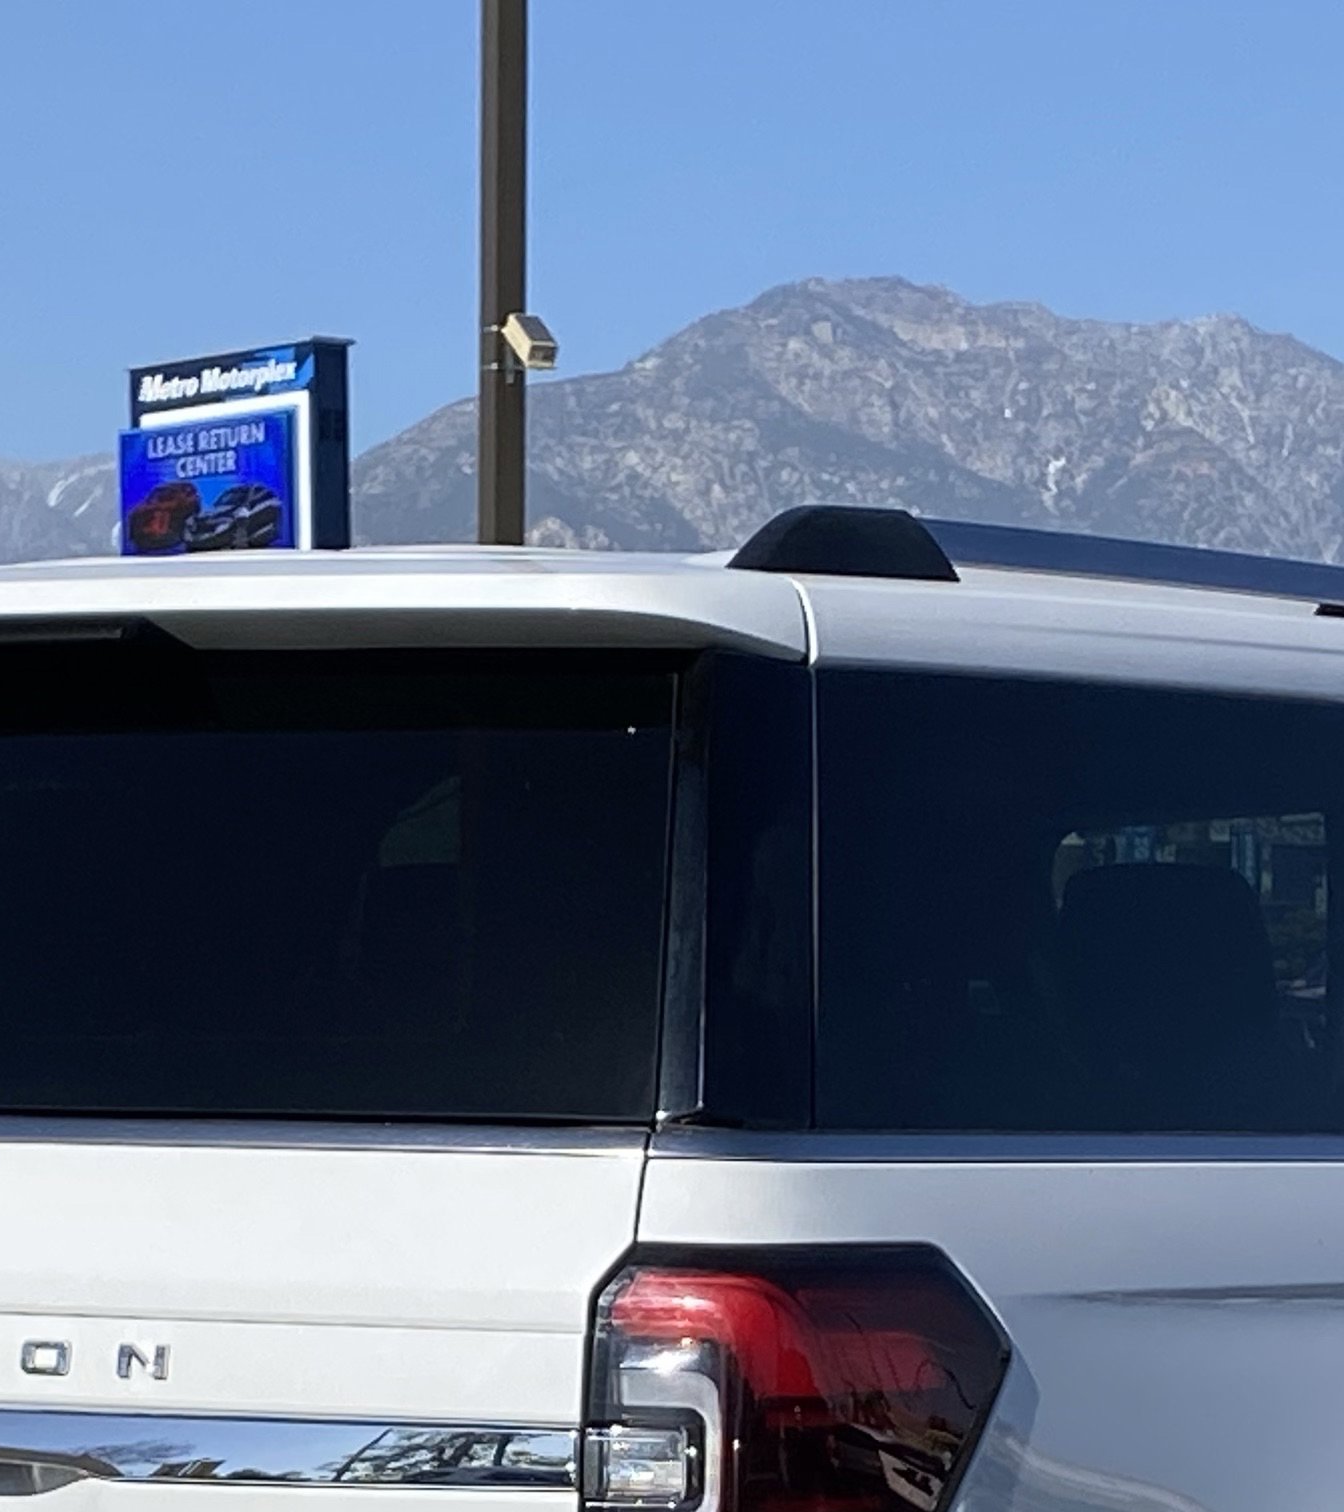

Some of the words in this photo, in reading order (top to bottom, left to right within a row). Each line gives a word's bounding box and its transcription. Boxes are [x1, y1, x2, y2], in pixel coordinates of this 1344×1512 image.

[138, 373, 199, 402] Metro
[200, 358, 297, 393] Motorplex
[147, 432, 195, 459] LEASE
[198, 422, 266, 451] RETURN
[176, 450, 236, 478] CENTER
